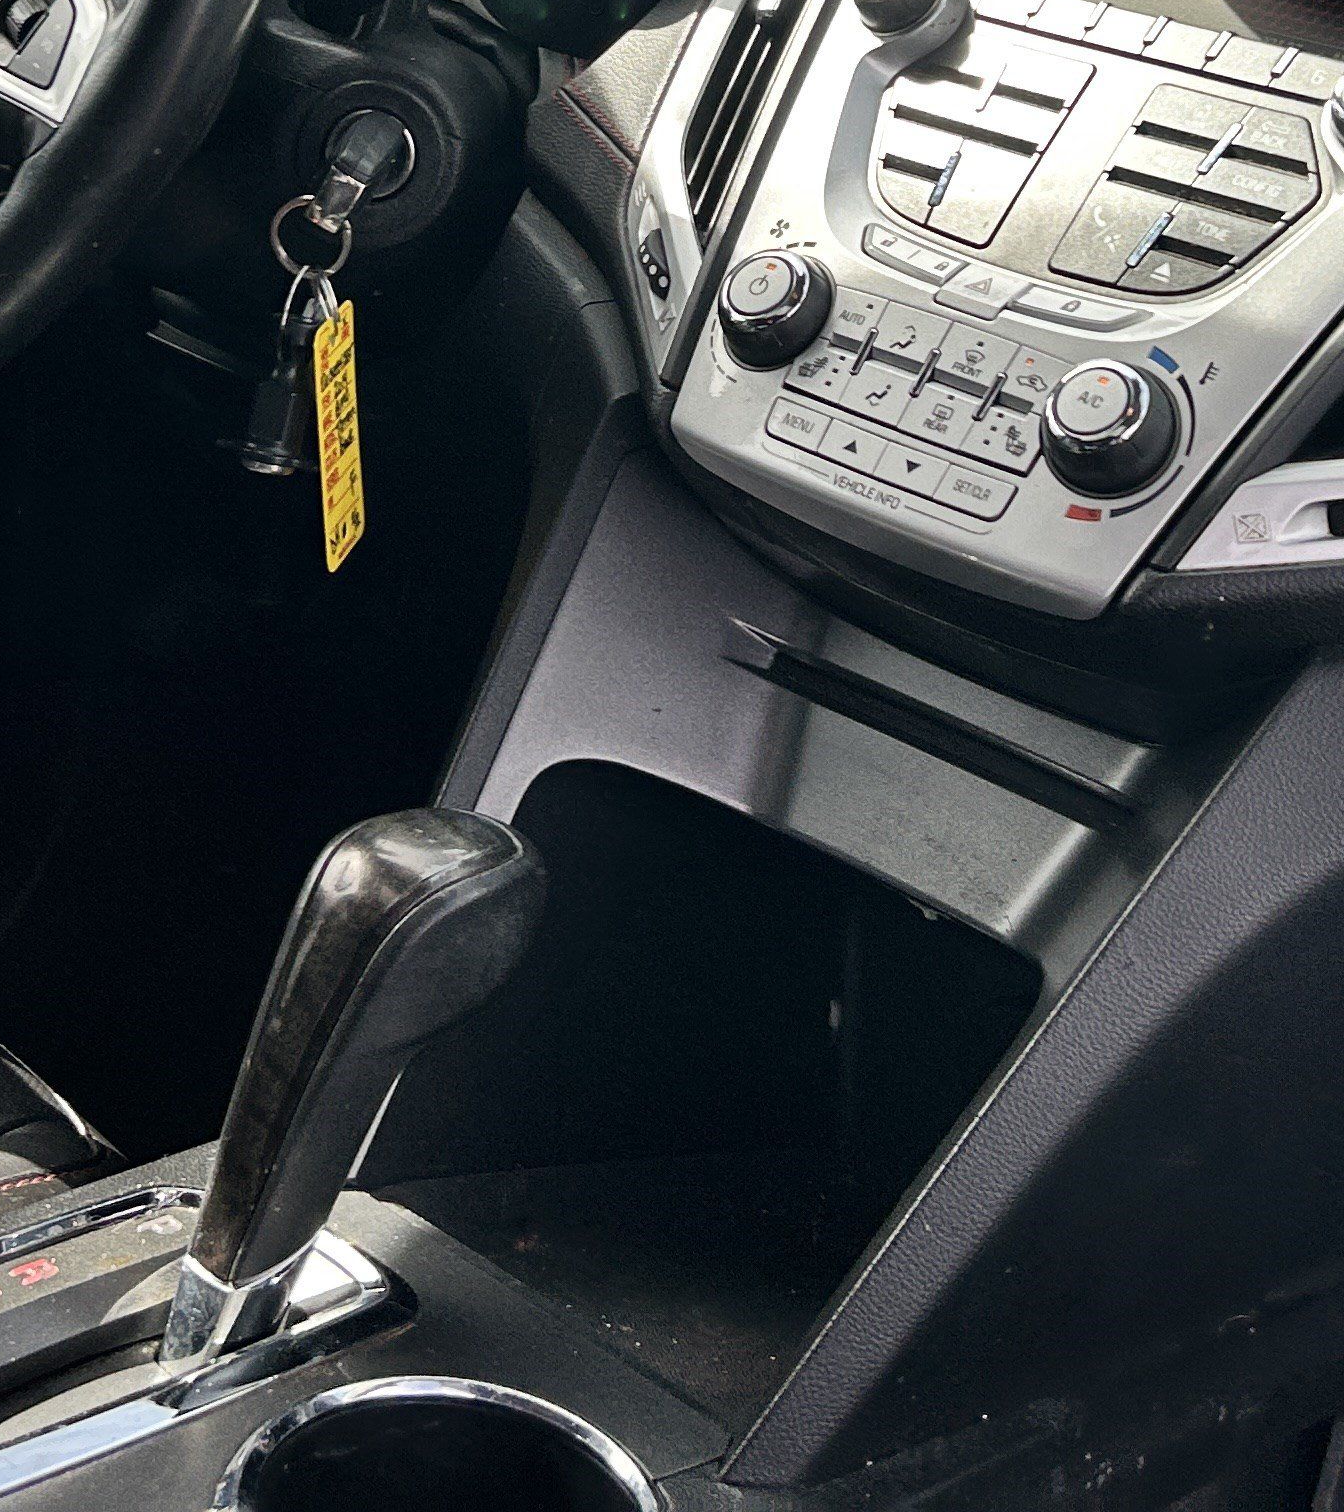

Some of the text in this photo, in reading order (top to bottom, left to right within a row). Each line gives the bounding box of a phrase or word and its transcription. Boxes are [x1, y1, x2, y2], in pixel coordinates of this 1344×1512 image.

[838, 309, 866, 326] AUTO
[951, 362, 984, 379] FRONT
[781, 412, 815, 435] MENU
[922, 418, 949, 434] REAR
[834, 472, 902, 510] VEHICLE INFO
[8, 1257, 60, 1287] R
